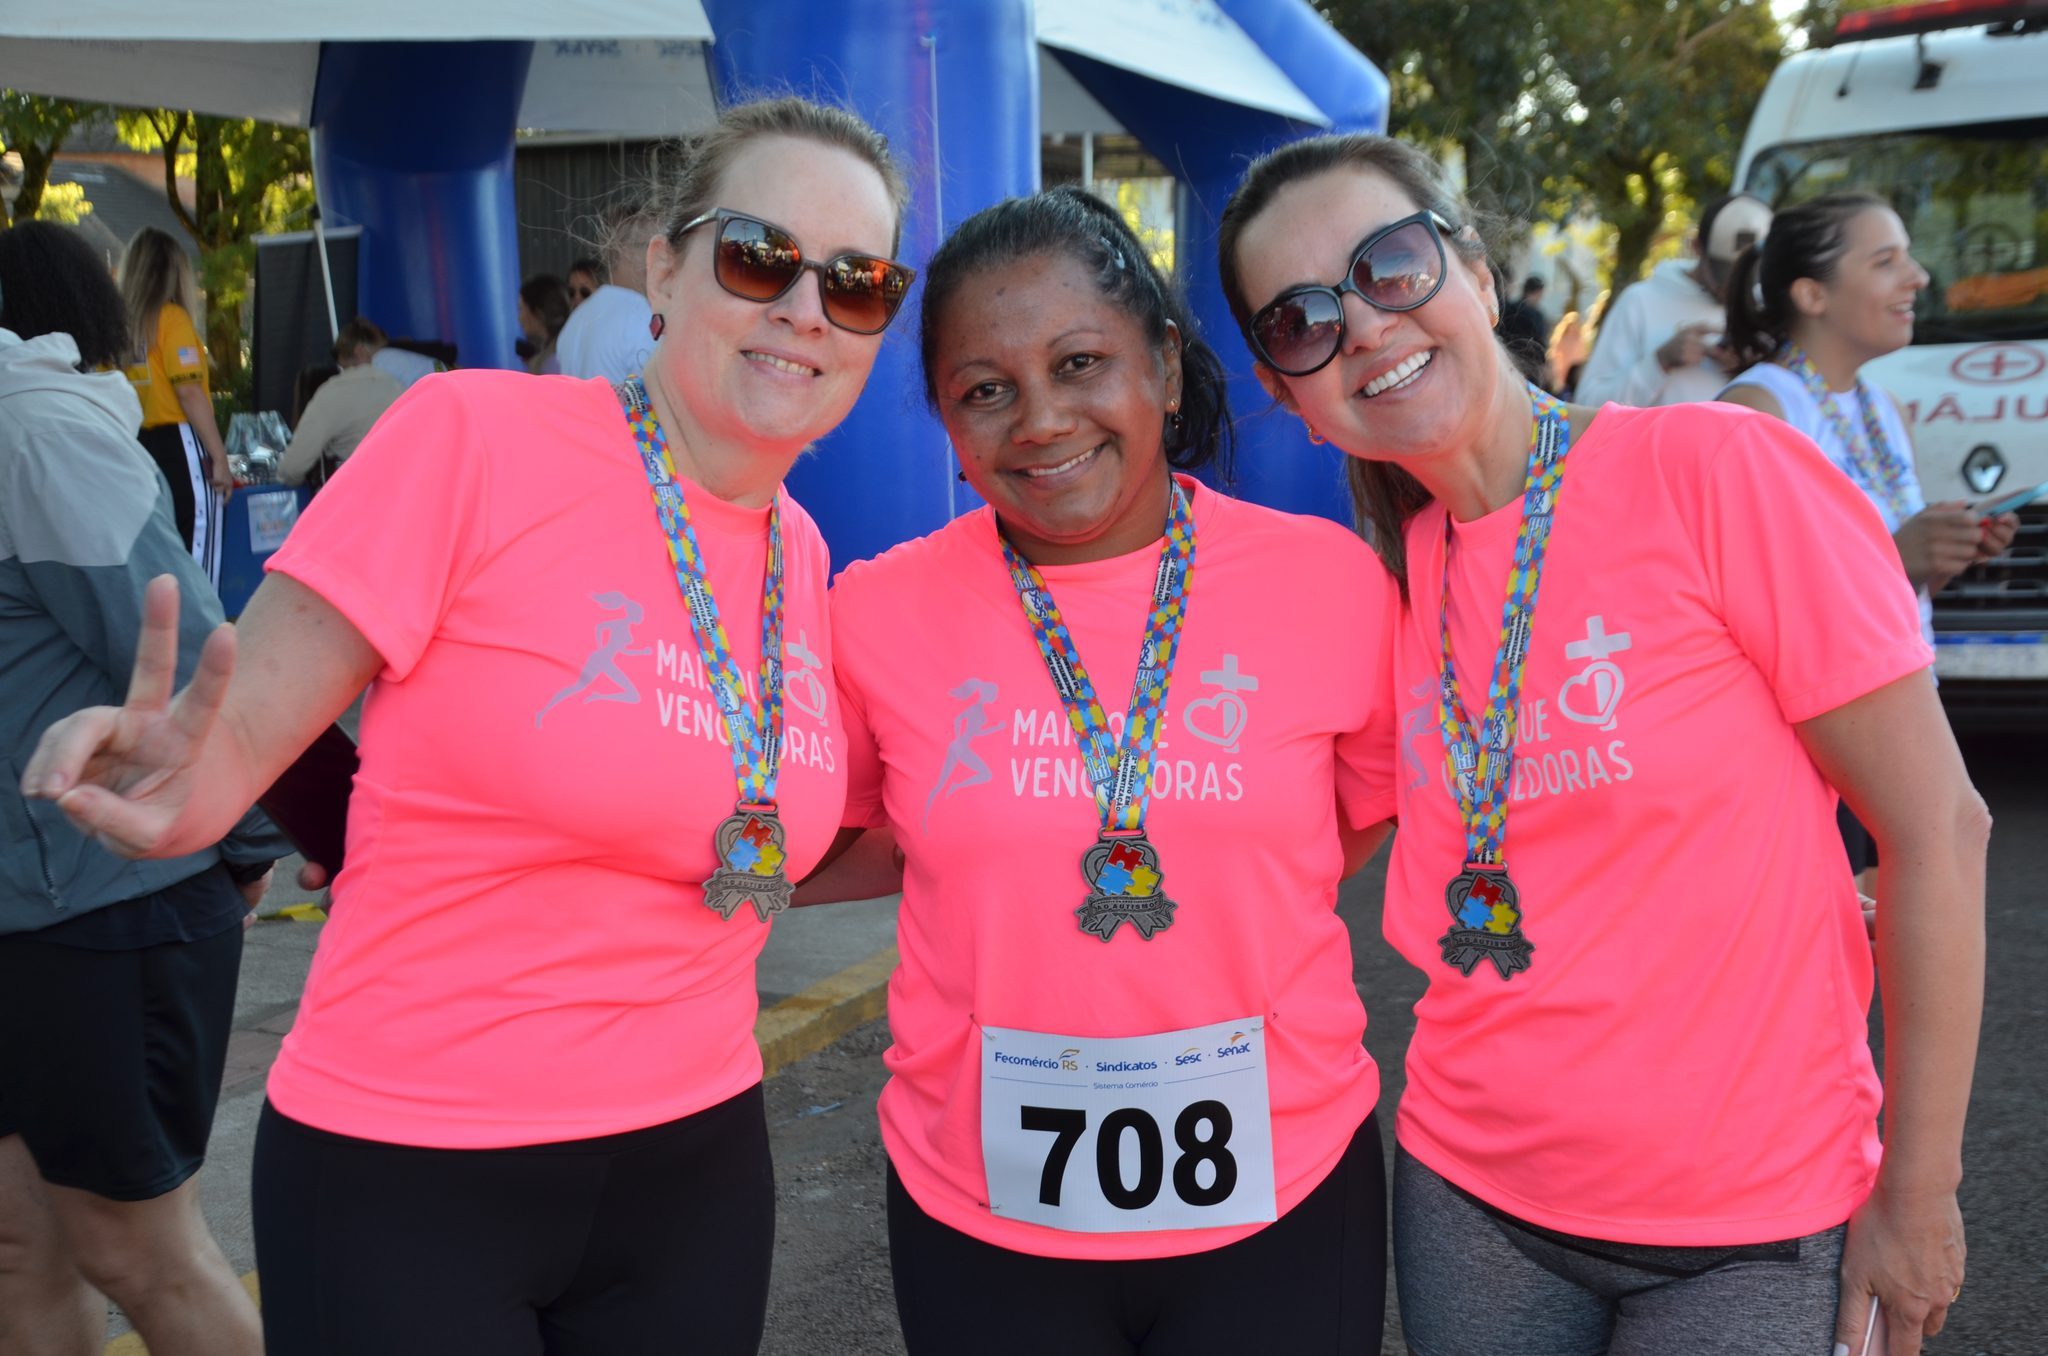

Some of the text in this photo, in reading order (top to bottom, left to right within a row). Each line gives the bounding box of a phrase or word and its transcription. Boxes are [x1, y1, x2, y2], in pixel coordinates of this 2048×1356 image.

[1029, 589, 1047, 618] Sesc
[657, 639, 713, 693] MAI
[656, 688, 835, 773] VENCRAS
[1012, 708, 1078, 746] MAI
[1492, 712, 1506, 748] Sesc
[1514, 698, 1551, 747] UE
[1011, 757, 1243, 801] VENCORAS
[1115, 748, 1131, 812] CONSCIENTIZAÇÃO
[1126, 765, 1136, 794] DESAFIO
[1125, 795, 1132, 806] EM
[1113, 902, 1154, 910] AUTISMO
[1474, 938, 1513, 947] AUTISMO
[995, 1042, 1250, 1072] Fecomércio RS Sindicatos Sesc Senac
[1093, 1080, 1158, 1090] Sistema Comércio
[1020, 1099, 1238, 1210] 708
